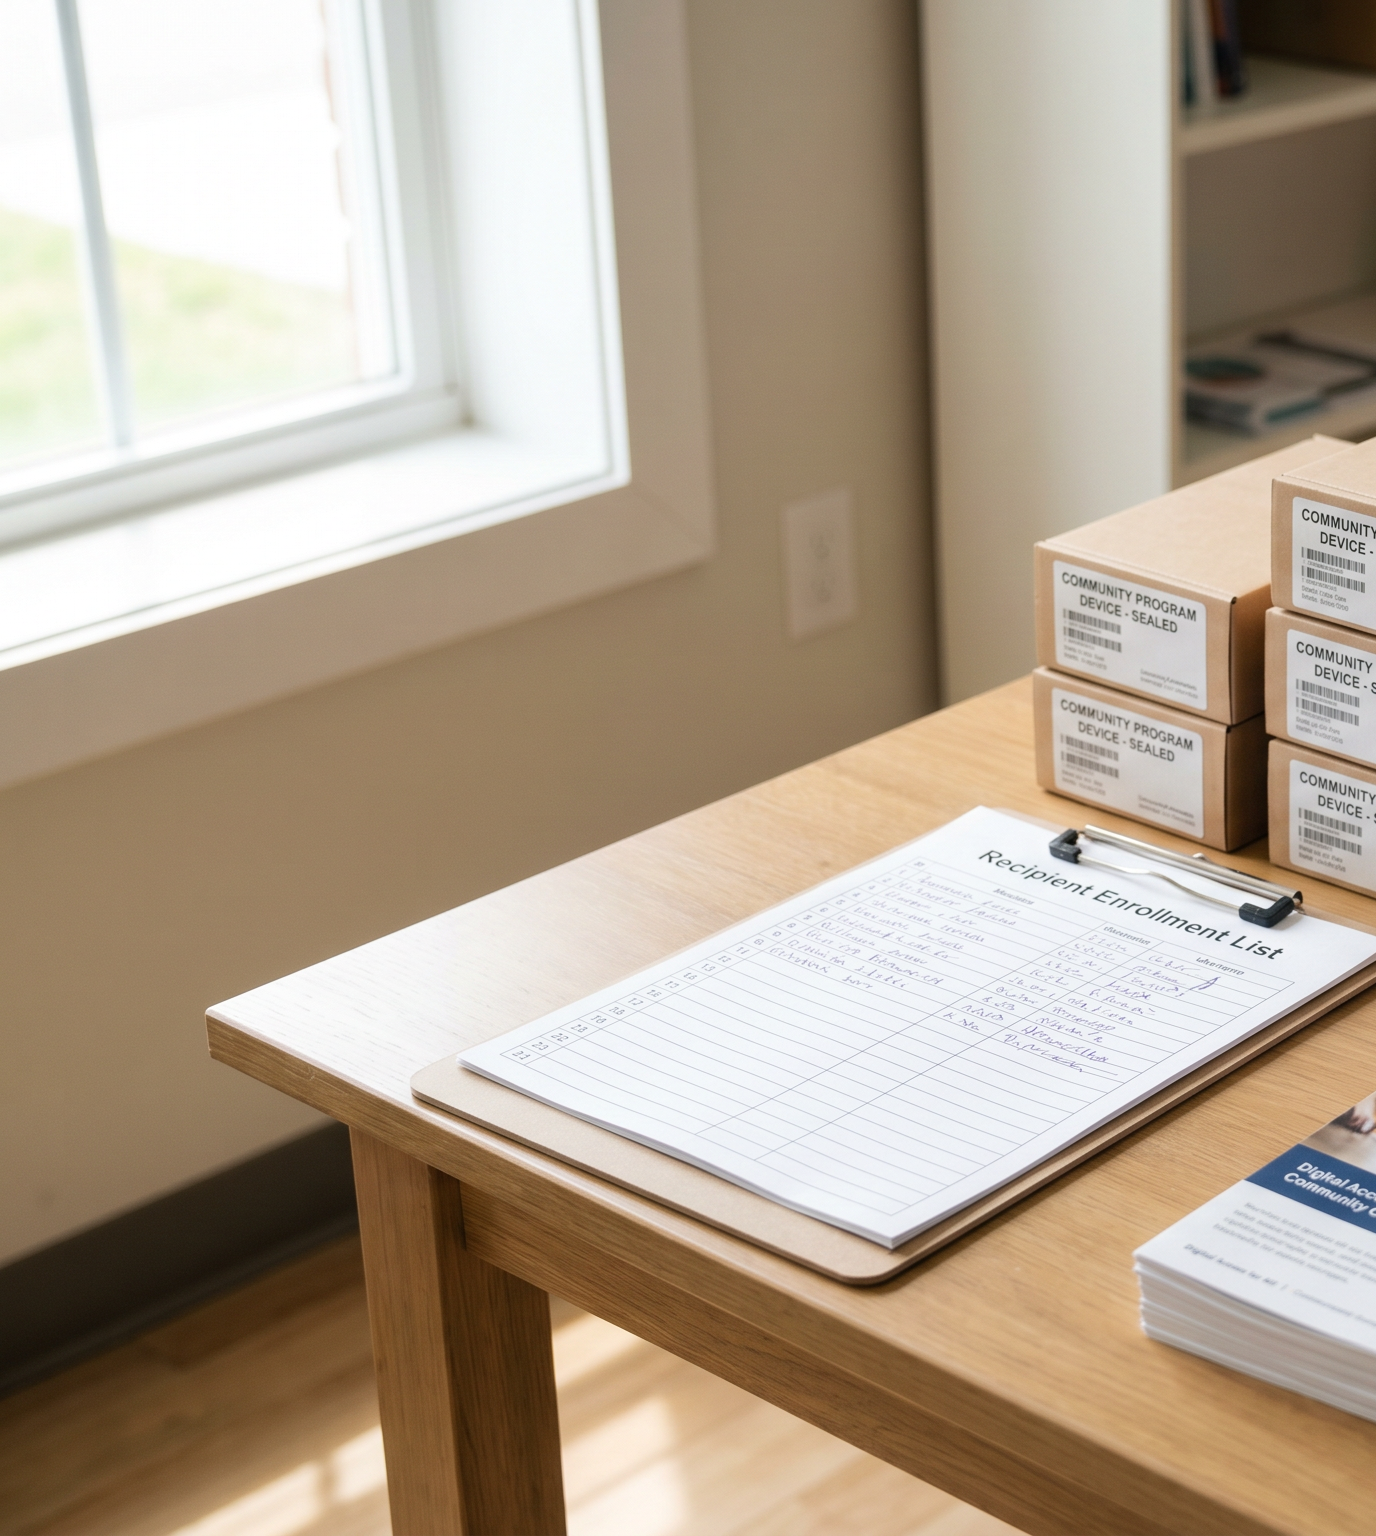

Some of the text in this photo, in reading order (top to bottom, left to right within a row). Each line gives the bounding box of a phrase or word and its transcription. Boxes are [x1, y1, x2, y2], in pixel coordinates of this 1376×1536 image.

[1320, 531, 1366, 556] DEVICE
[1061, 571, 1197, 622] COMMUNITY PROGRAM
[1079, 594, 1122, 617] DEVICE
[1131, 609, 1178, 634] SEALED
[1296, 641, 1373, 674] COMMUNITY
[1314, 664, 1360, 689] DEVICE
[1060, 698, 1193, 751] COMMUNITY PROGRAM
[1078, 720, 1120, 745] DEVICE
[1129, 737, 1175, 762] SEALED
[1299, 771, 1376, 805] COMMUNITY
[1317, 794, 1363, 820] DEVICE
[979, 850, 1284, 960] Recipient Enrollment List
